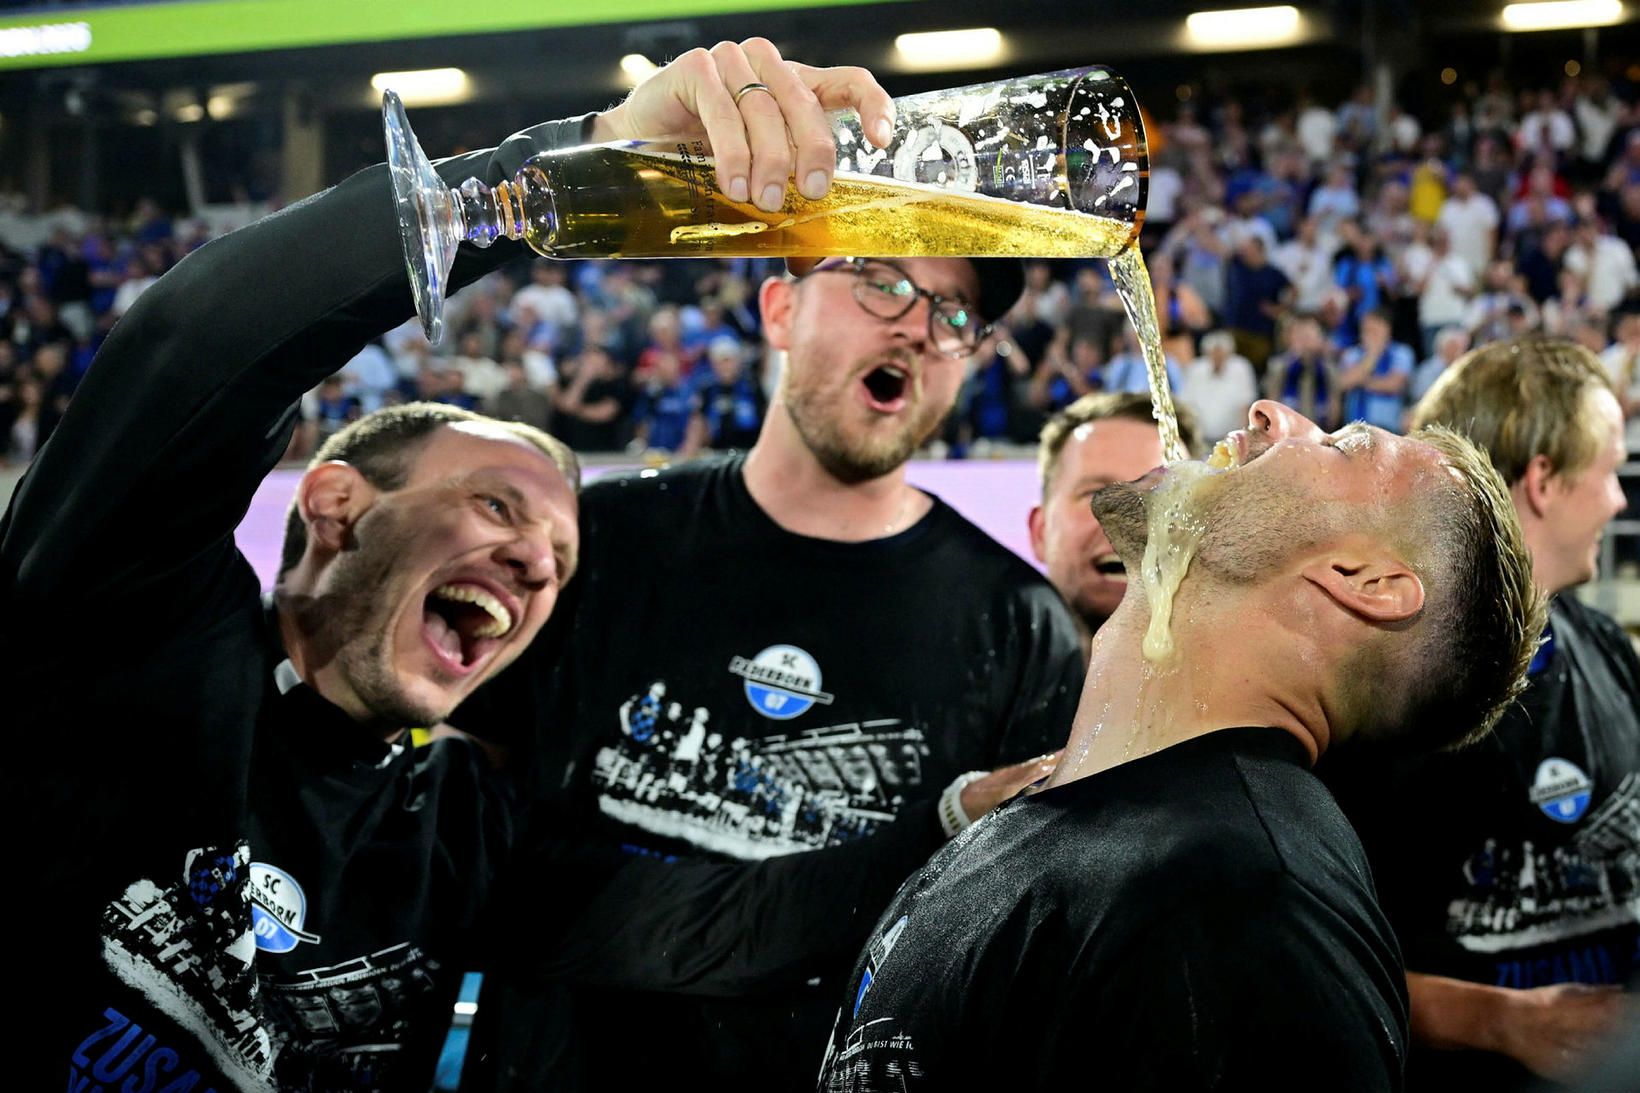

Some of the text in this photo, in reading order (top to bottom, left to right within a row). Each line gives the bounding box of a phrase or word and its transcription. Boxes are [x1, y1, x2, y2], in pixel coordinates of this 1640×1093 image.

[263, 874, 281, 895] SC
[251, 882, 297, 925] ERBORN
[255, 916, 279, 940] 07
[72, 1007, 217, 1093] ZUSA
[890, 1040, 904, 1049] WIE
